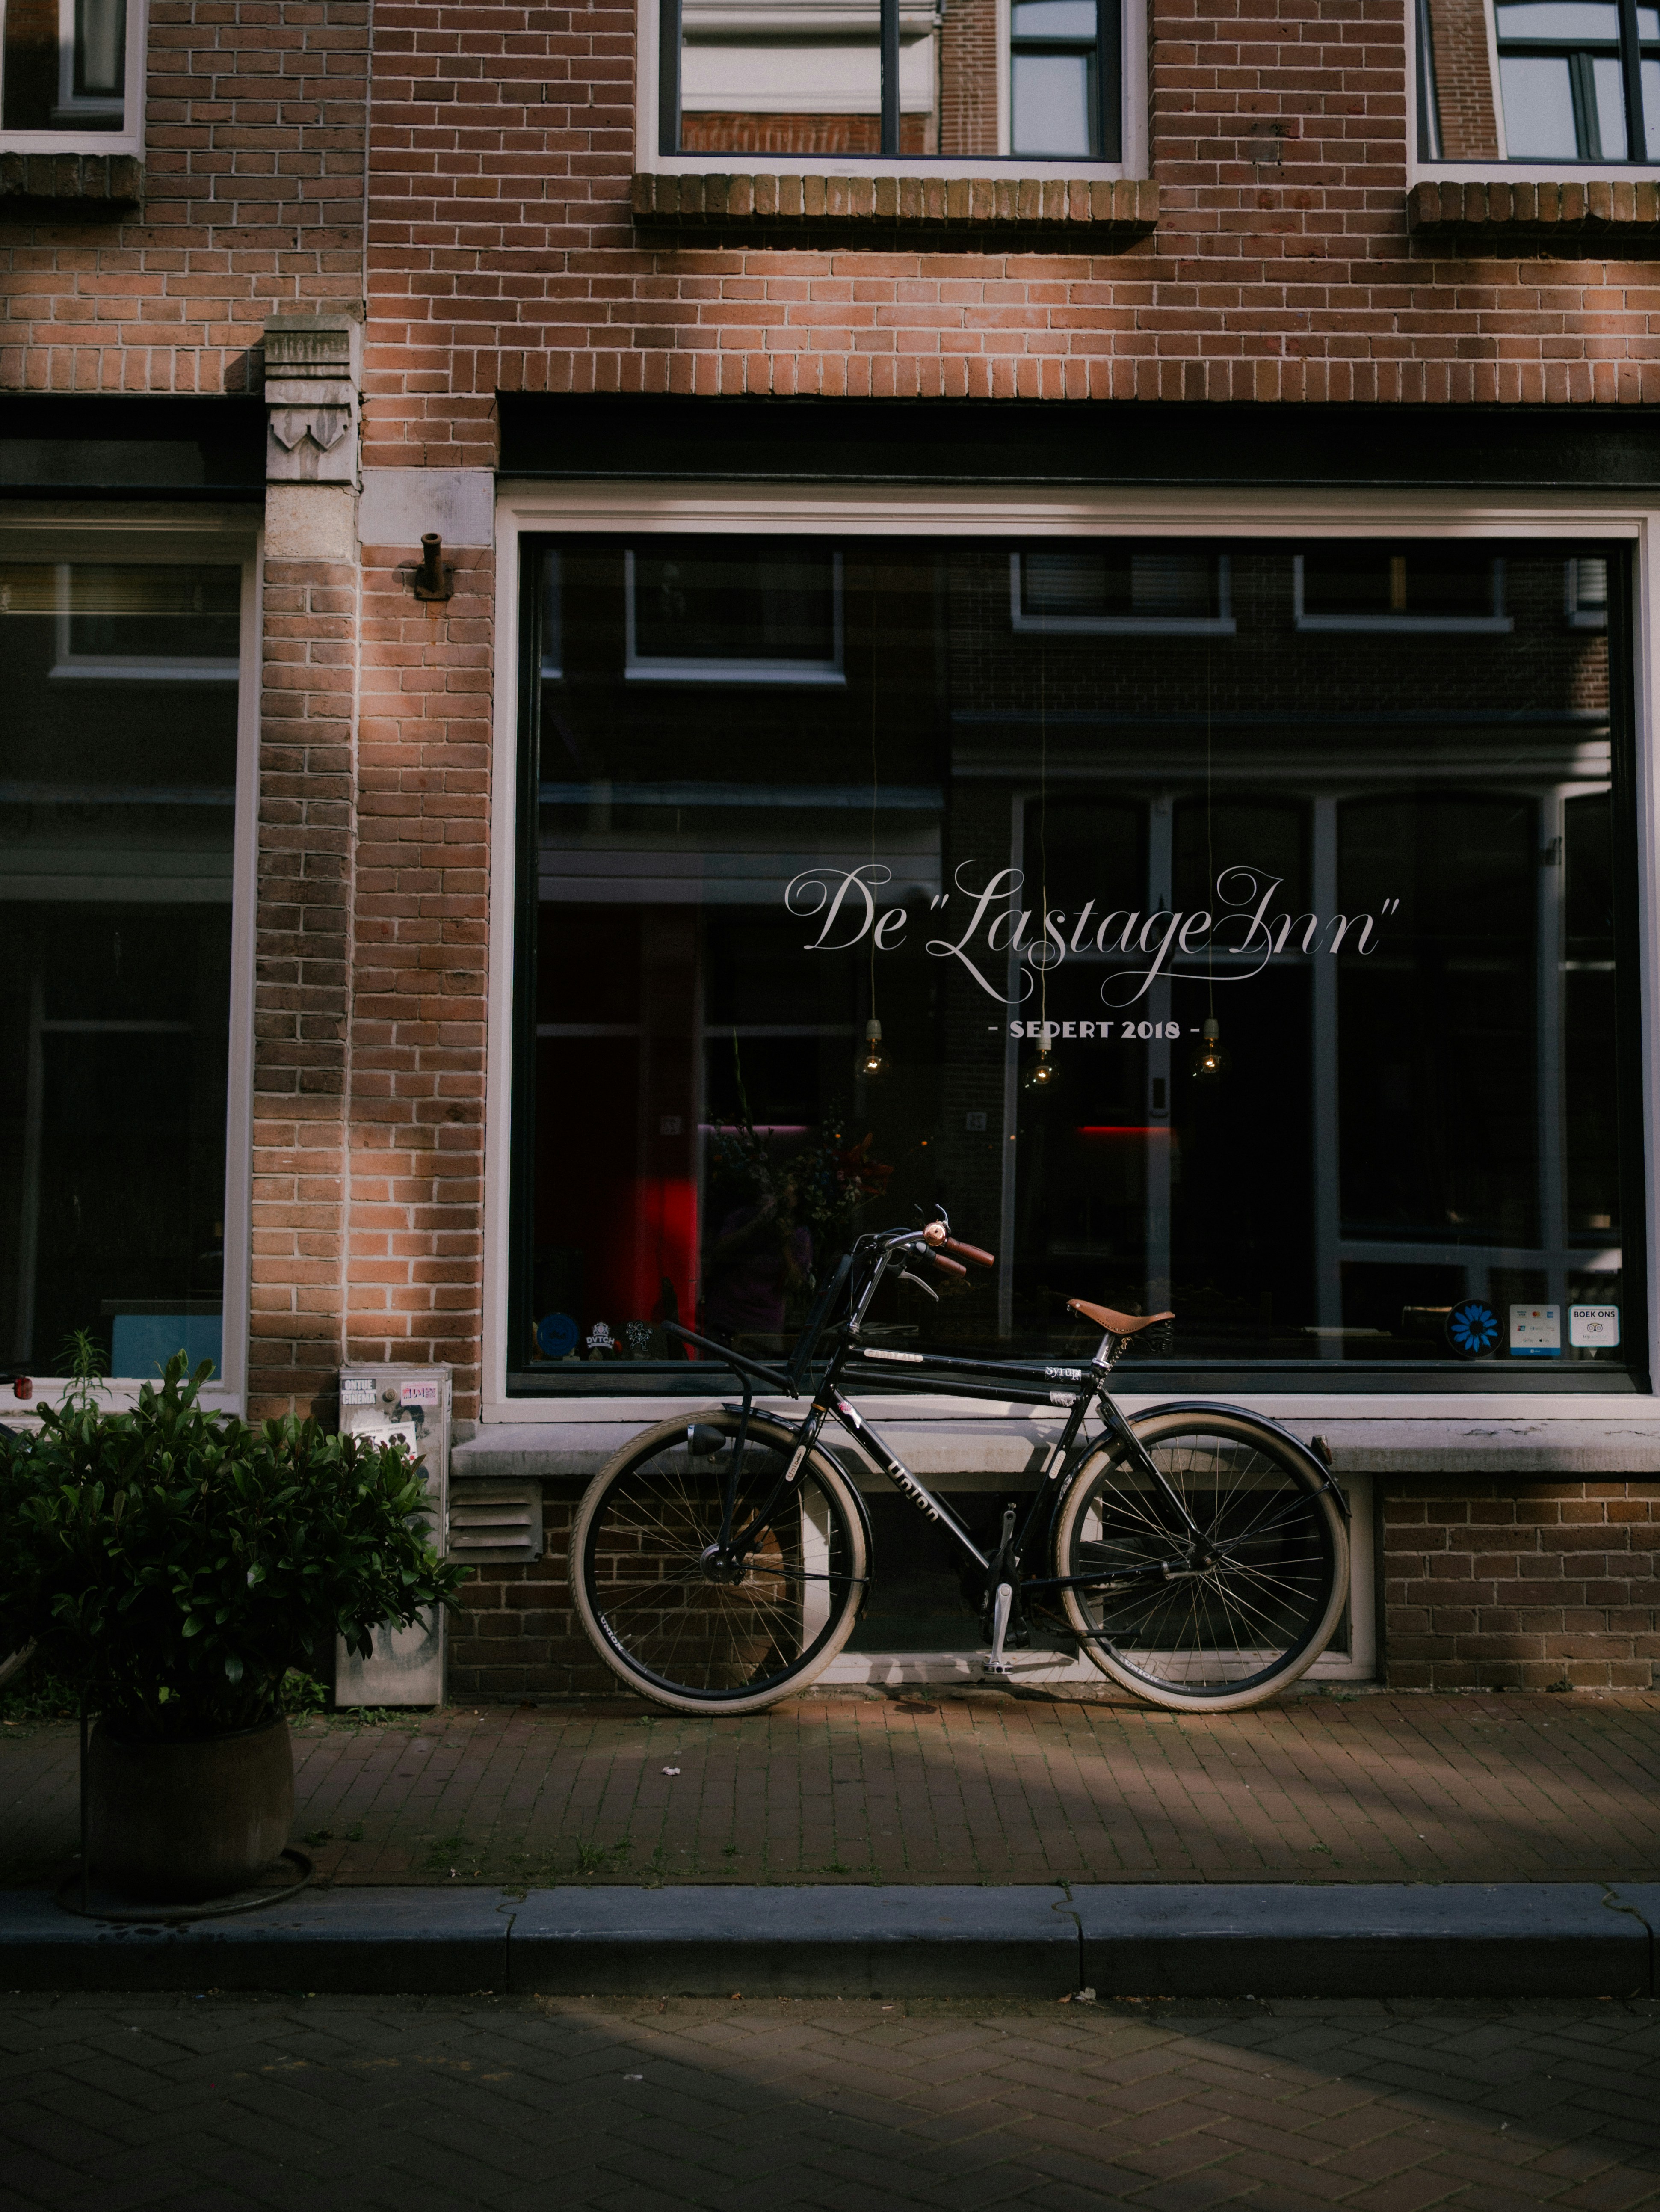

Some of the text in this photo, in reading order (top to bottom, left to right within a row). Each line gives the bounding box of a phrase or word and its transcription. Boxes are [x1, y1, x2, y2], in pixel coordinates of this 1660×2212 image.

[784, 863, 907, 951] De
[1010, 1020, 1115, 1039] SEDERT
[1121, 1020, 1181, 1039] 2018
[586, 1336, 615, 1345] DVTCH
[1045, 1367, 1081, 1381] Syrup
[342, 1394, 376, 1405] CINEMA
[1051, 1454, 1065, 1475] Union
[887, 1460, 939, 1522] Union
[600, 1616, 624, 1651] UNION
[1124, 1659, 1160, 1683] UNION
